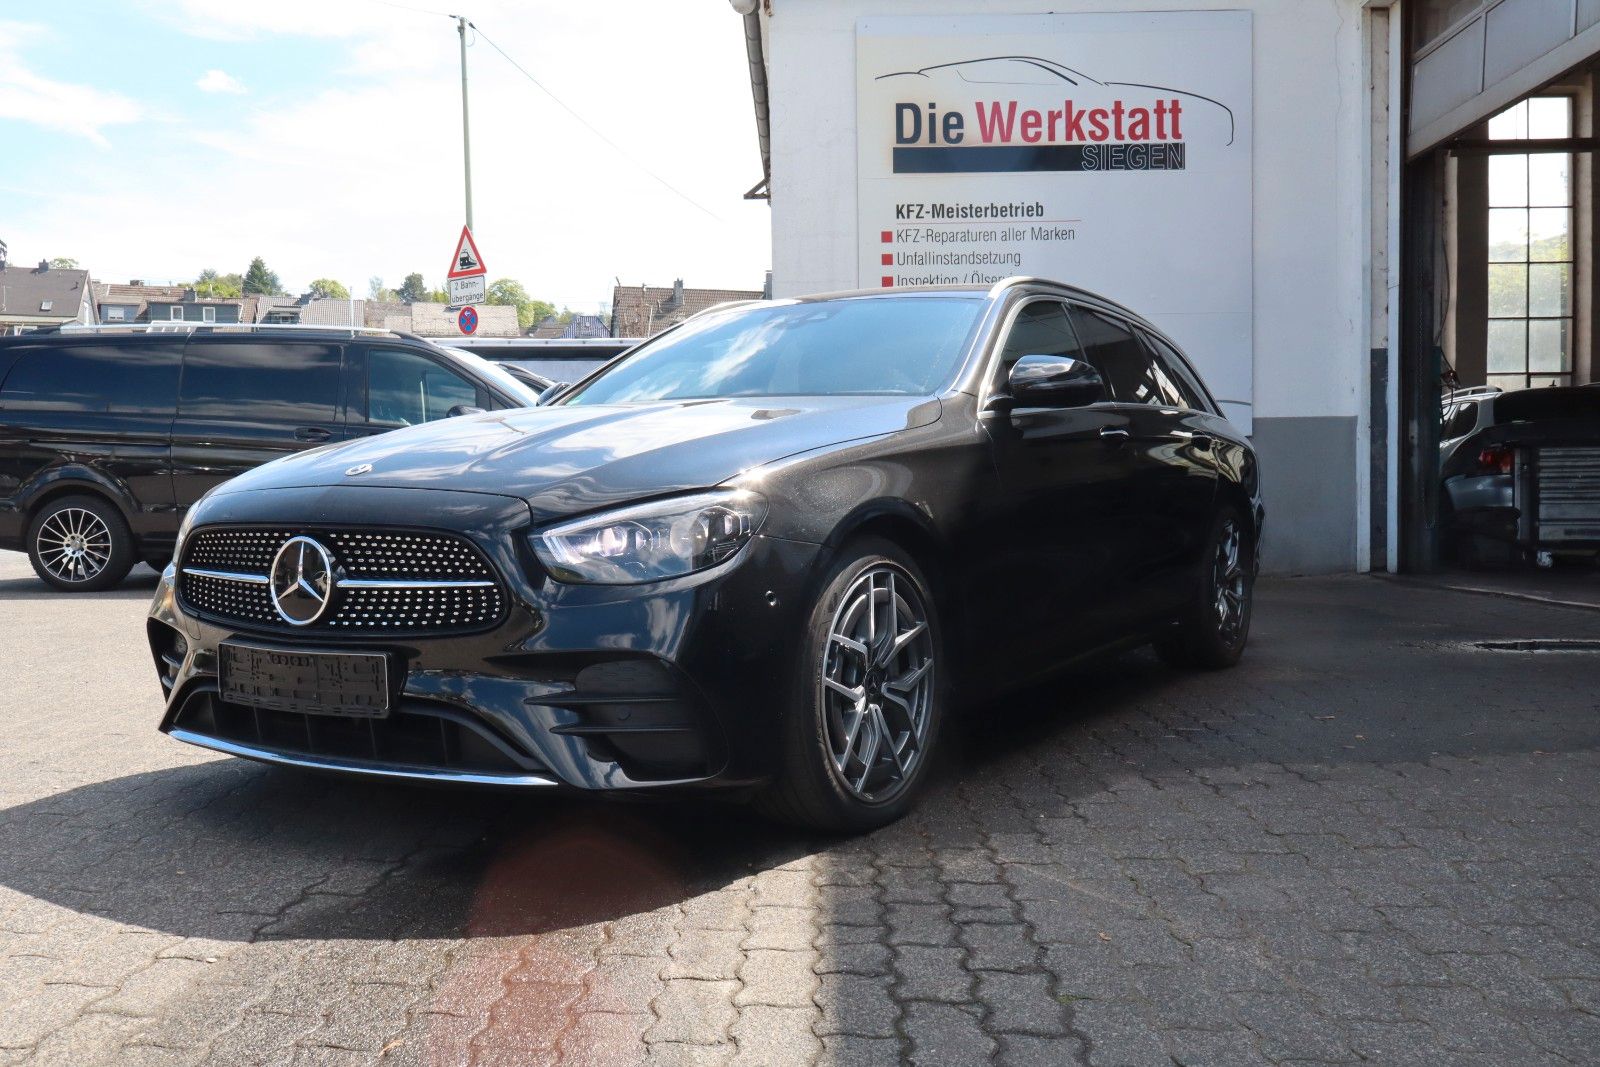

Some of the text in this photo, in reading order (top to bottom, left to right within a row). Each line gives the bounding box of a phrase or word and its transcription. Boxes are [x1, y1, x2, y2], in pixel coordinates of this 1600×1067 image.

[894, 99, 1183, 145] Die Werkstatt
[1081, 142, 1185, 171] SIEGEN
[895, 202, 1045, 219] KFZ-Meisterbetrieb
[896, 226, 1076, 245] KFZ-Reparaturen aller Marken
[896, 250, 1022, 267] Unfallinstandsetzung
[454, 281, 459, 291] 2
[896, 274, 959, 287] Inspektion
